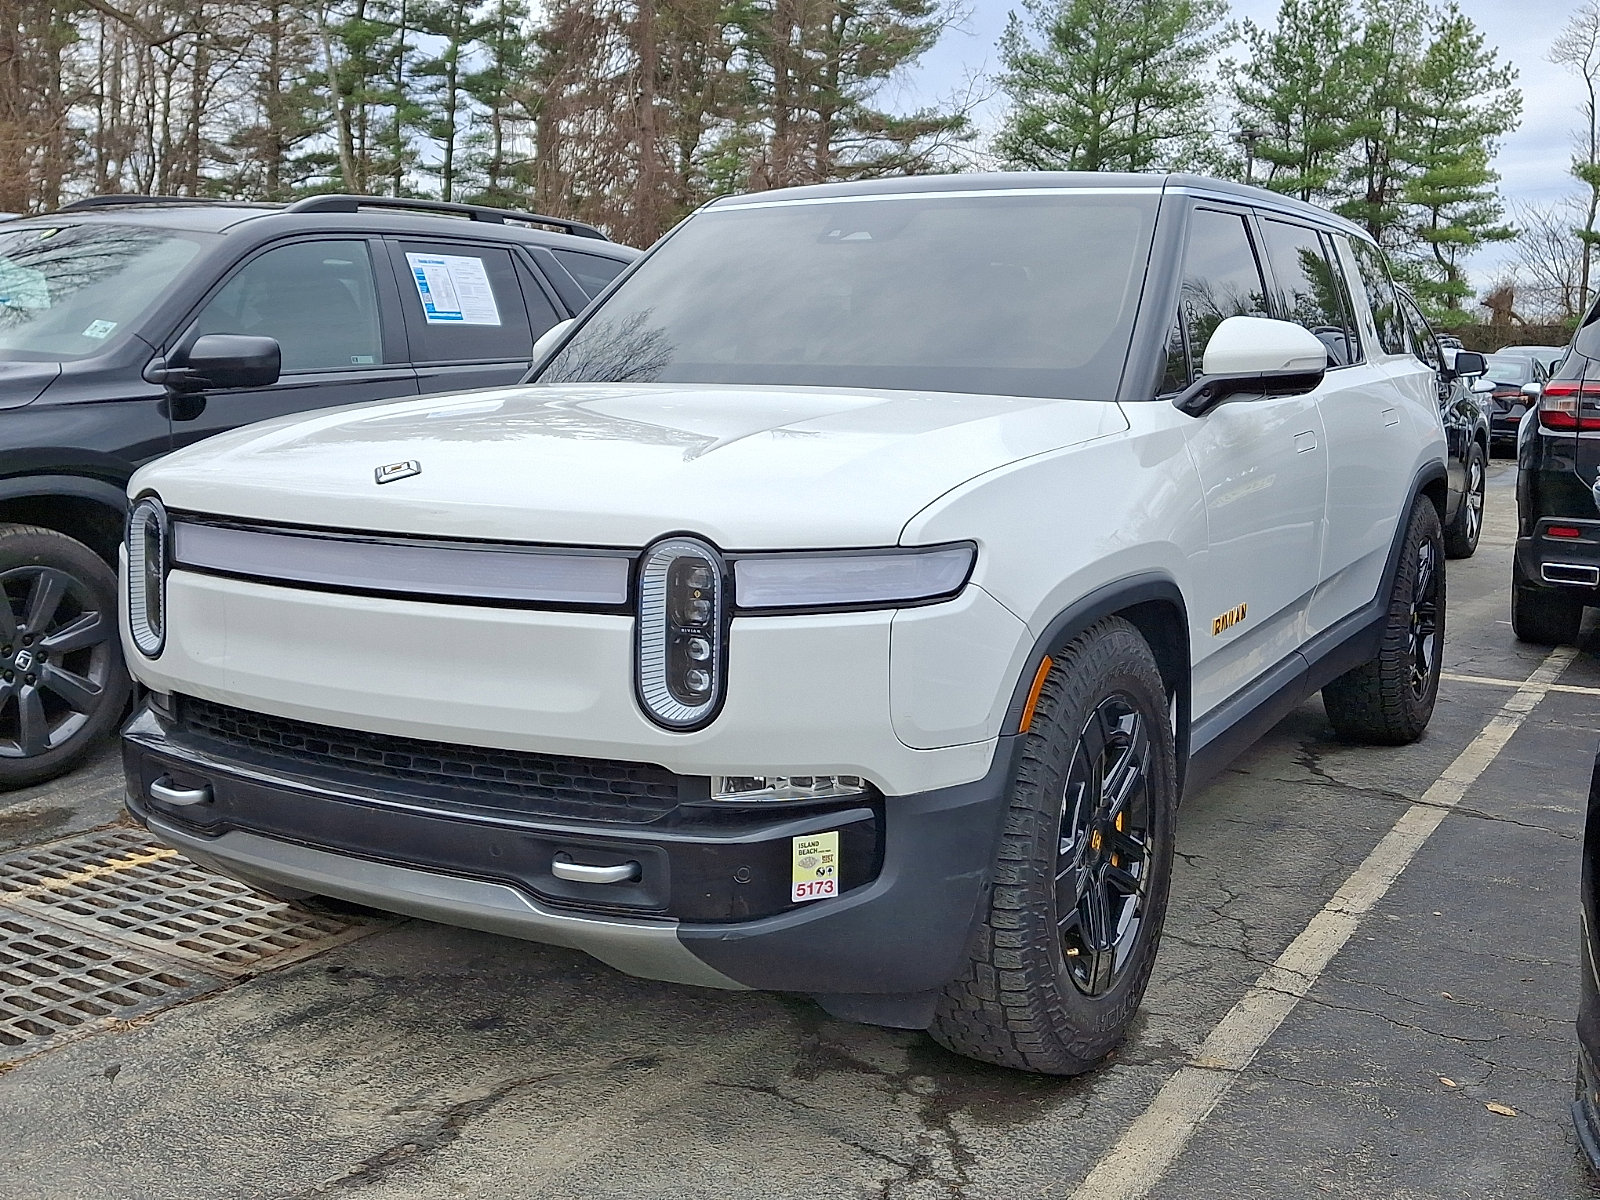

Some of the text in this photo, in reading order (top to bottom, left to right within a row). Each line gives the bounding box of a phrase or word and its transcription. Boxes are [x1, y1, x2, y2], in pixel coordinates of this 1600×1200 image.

[1211, 602, 1247, 637] RIVIAN
[798, 840, 820, 849] ISLAND
[798, 848, 818, 856] BEACH
[796, 880, 834, 897] 5173
